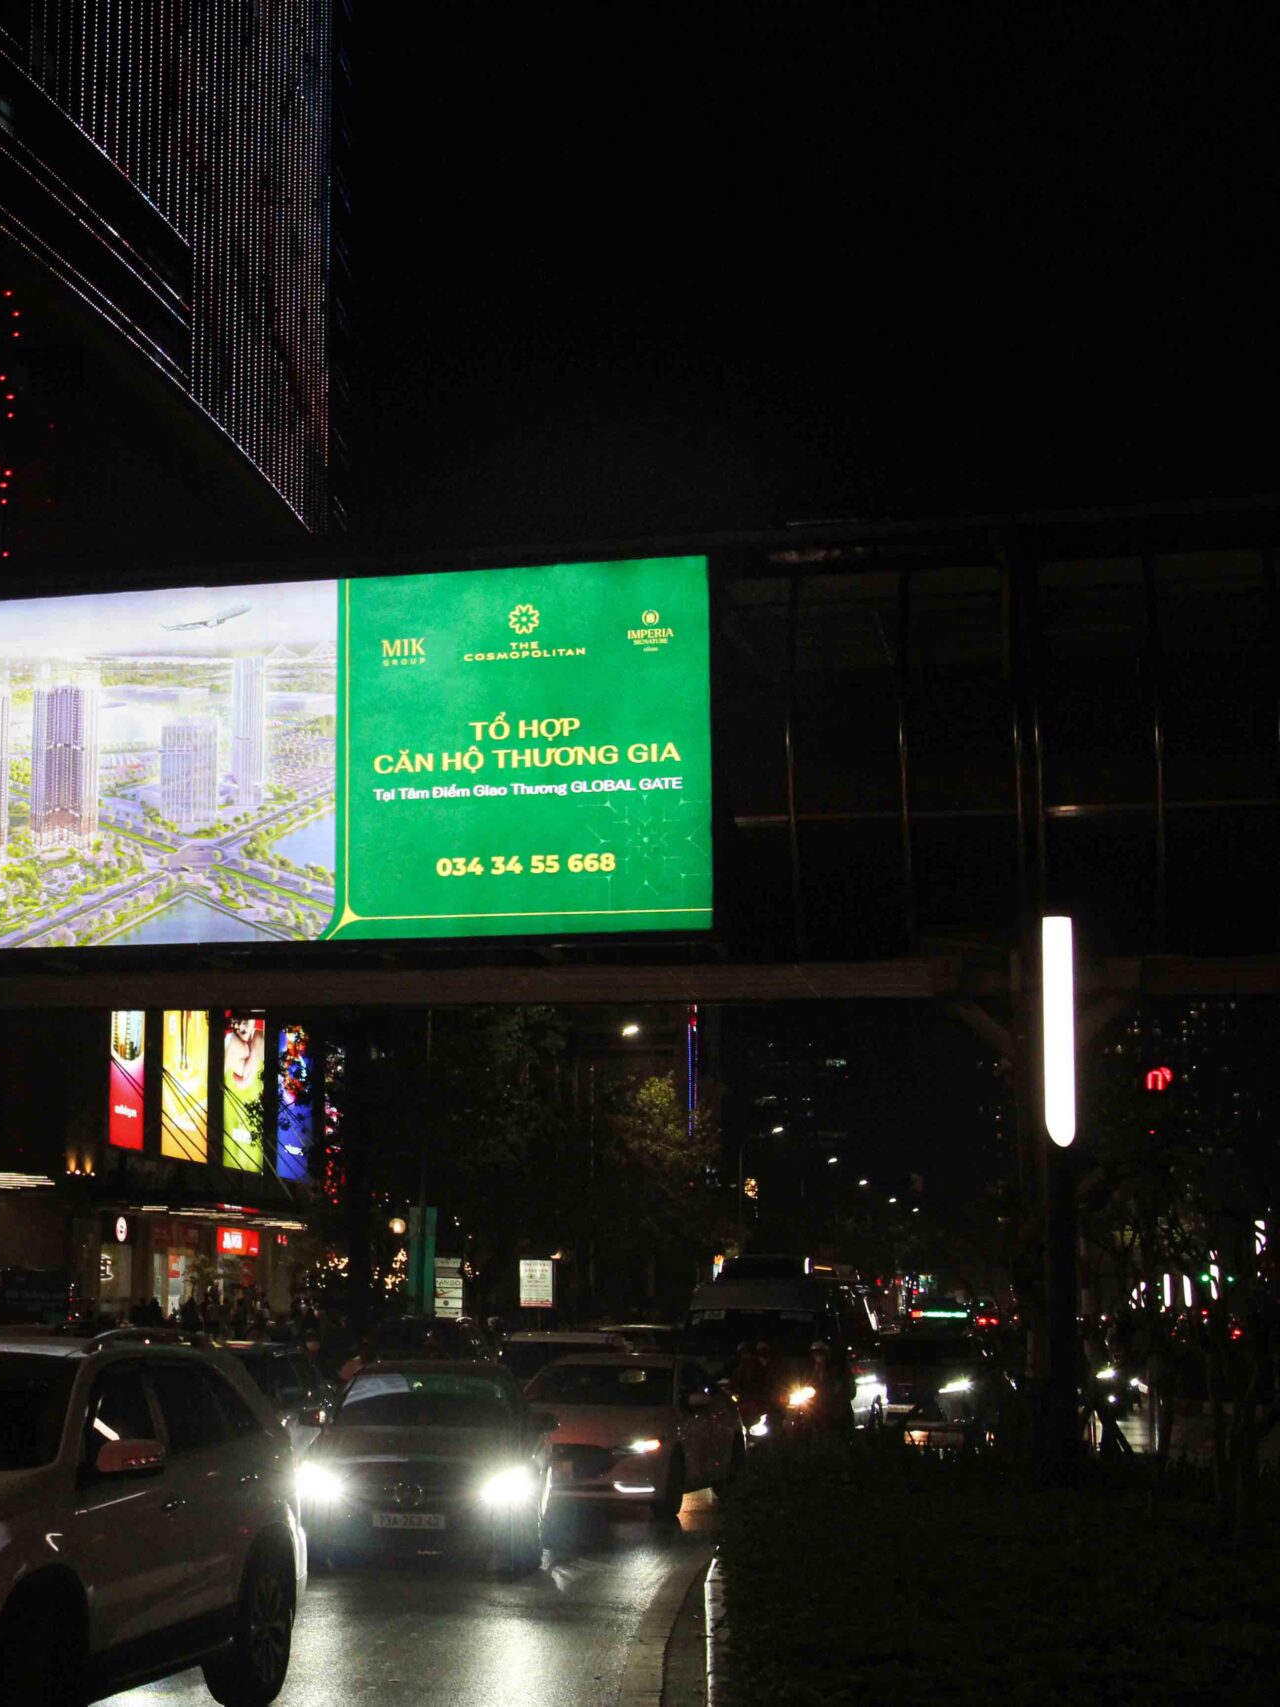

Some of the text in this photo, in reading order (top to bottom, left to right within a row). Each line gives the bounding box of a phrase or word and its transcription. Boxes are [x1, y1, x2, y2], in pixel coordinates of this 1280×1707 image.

[627, 628, 674, 639] IMPERIA
[382, 638, 426, 657] MIK
[463, 647, 586, 662] COSMOPOLITAN
[510, 641, 539, 650] THE
[383, 658, 426, 667] GROUP
[469, 712, 580, 742] TỔ HỢP
[373, 742, 682, 774] CĂN HỘ THƯƠNG GIA
[373, 776, 683, 802] Tại Tâm Điểm Giao Thương GLOBAL GATE
[436, 852, 616, 877] 034 34 55 668
